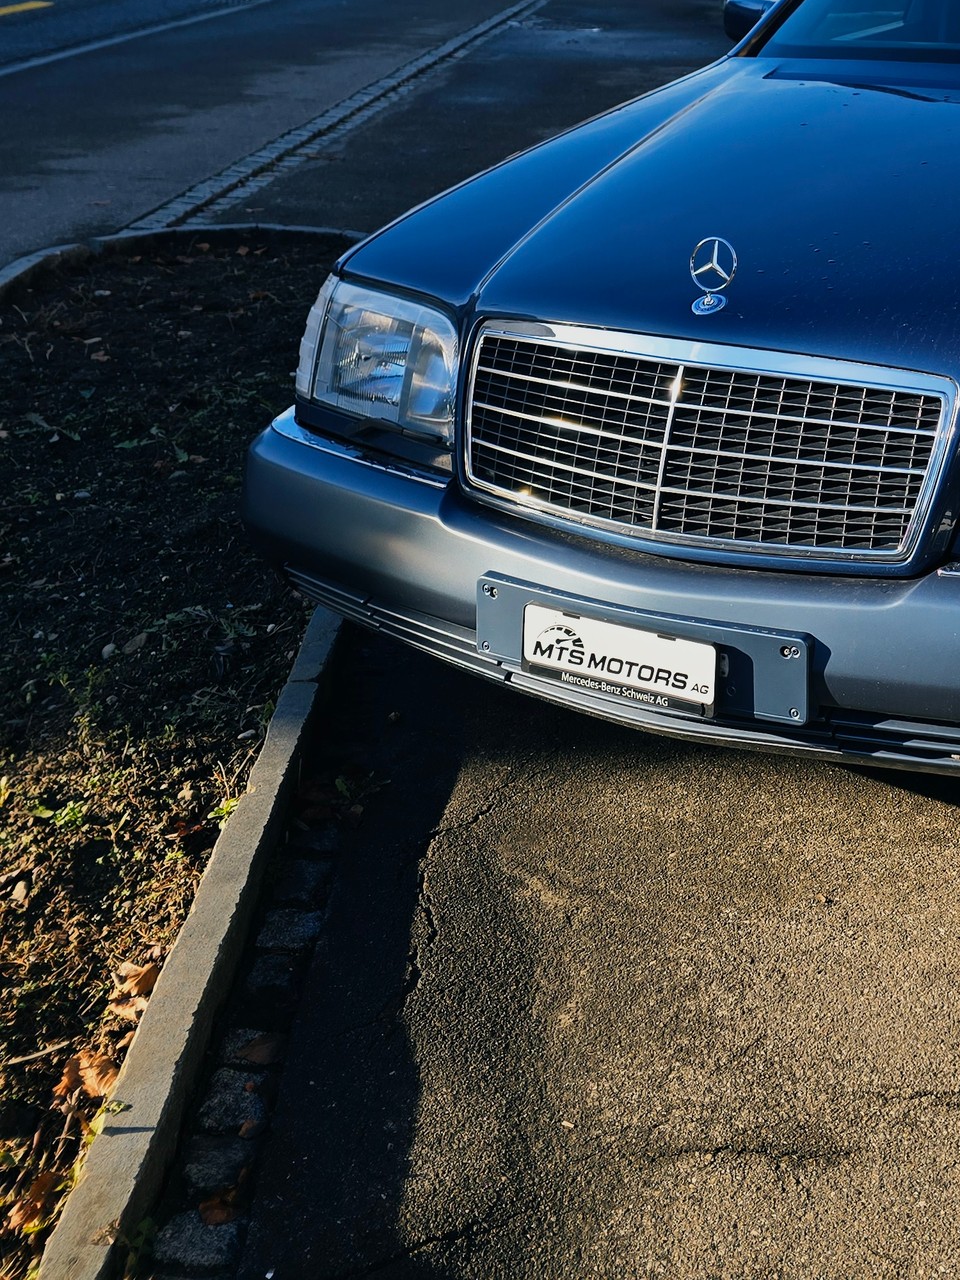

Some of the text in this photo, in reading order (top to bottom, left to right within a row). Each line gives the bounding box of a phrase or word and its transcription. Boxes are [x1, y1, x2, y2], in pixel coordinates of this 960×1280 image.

[532, 640, 710, 695] MTS MOTORS AG
[560, 671, 669, 707] Mercedes-Benz Schweiz AG
